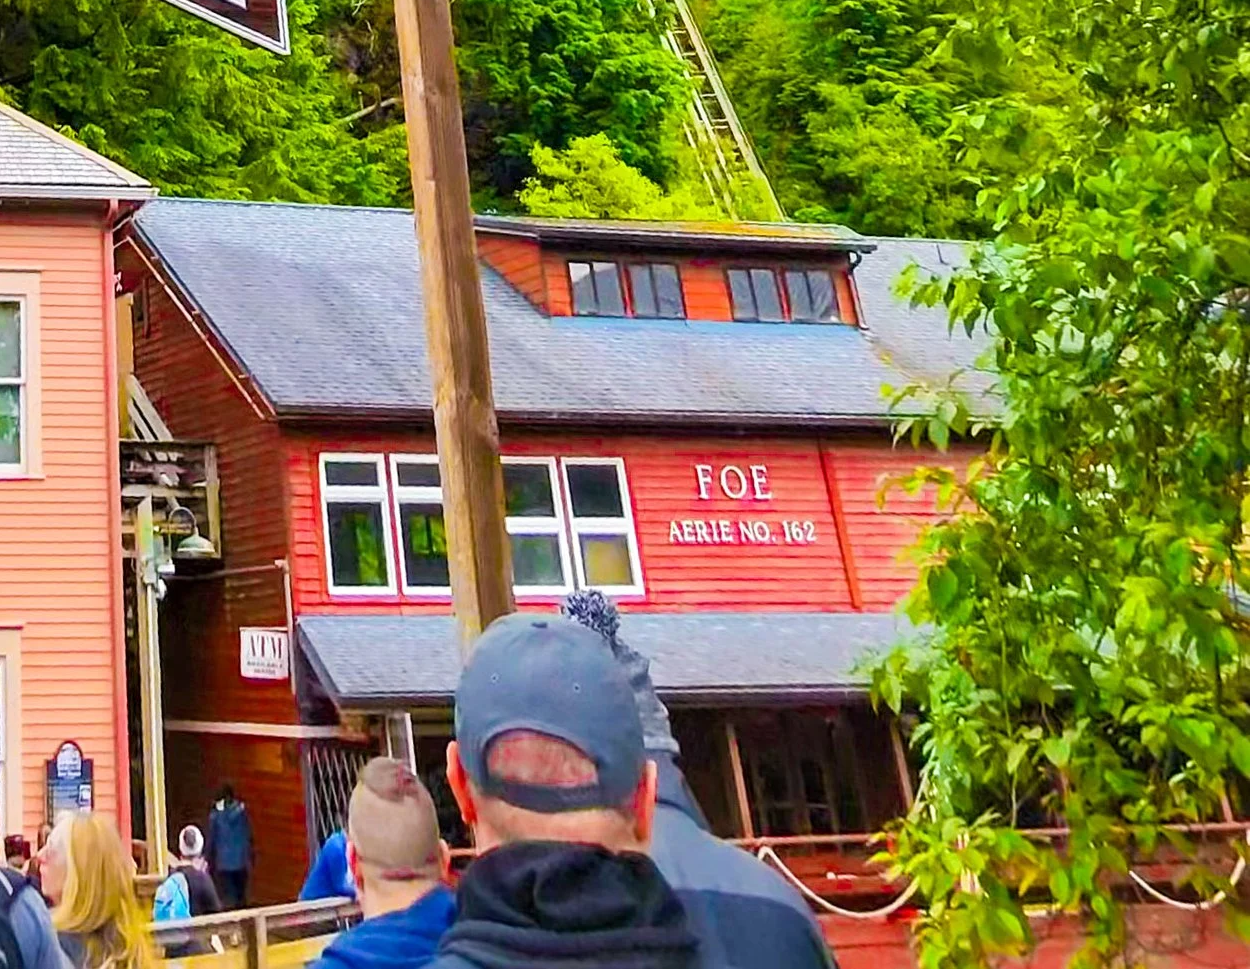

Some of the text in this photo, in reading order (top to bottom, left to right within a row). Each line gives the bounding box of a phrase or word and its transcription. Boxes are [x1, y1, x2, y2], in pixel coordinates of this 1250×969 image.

[695, 464, 773, 500] FOE
[668, 519, 818, 543] AERIE NO. 162
[247, 635, 282, 659] ATM
